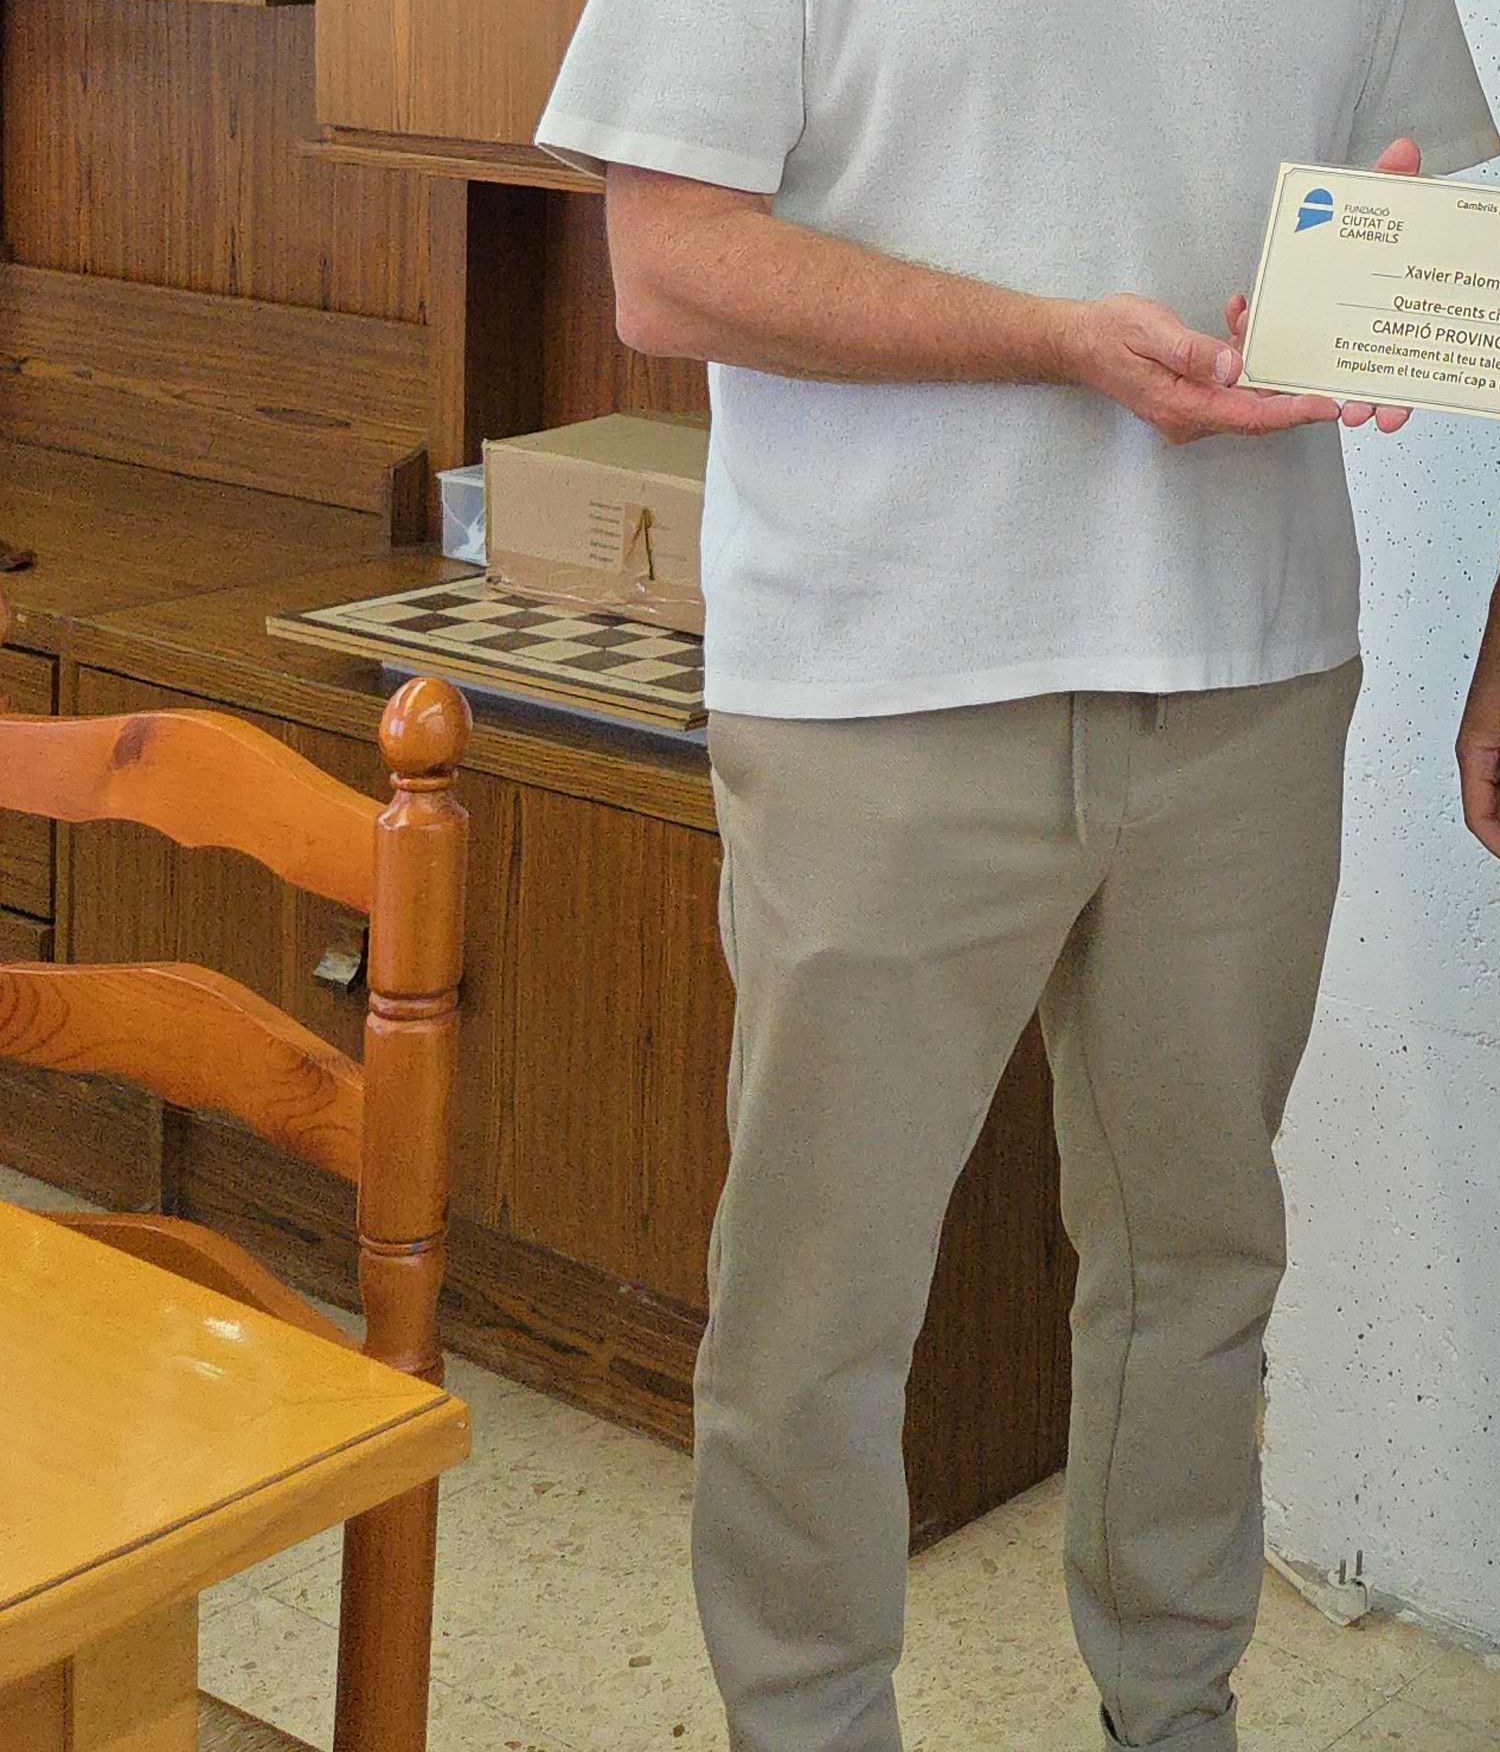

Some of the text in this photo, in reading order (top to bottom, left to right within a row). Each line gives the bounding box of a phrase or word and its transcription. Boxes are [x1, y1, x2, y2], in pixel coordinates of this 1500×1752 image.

[1344, 202, 1391, 218] FUNDACIÓ
[1341, 214, 1405, 233] CIUTAT DE
[1339, 227, 1400, 244] CAMBRILS
[1404, 265, 1453, 285] Xavier
[1392, 295, 1486, 320] Quatre-cents
[1371, 319, 1432, 340] CAMPIÓ
[1335, 337, 1350, 351] En
[1352, 340, 1441, 362] reconeixament
[1442, 351, 1455, 364] al
[1457, 354, 1477, 366] teu
[1336, 357, 1395, 377] Impulsem
[1396, 364, 1408, 377] el
[1410, 367, 1431, 380] teu
[1432, 370, 1464, 384] camí
[1464, 374, 1487, 390] cap
[1488, 379, 1497, 389] a
